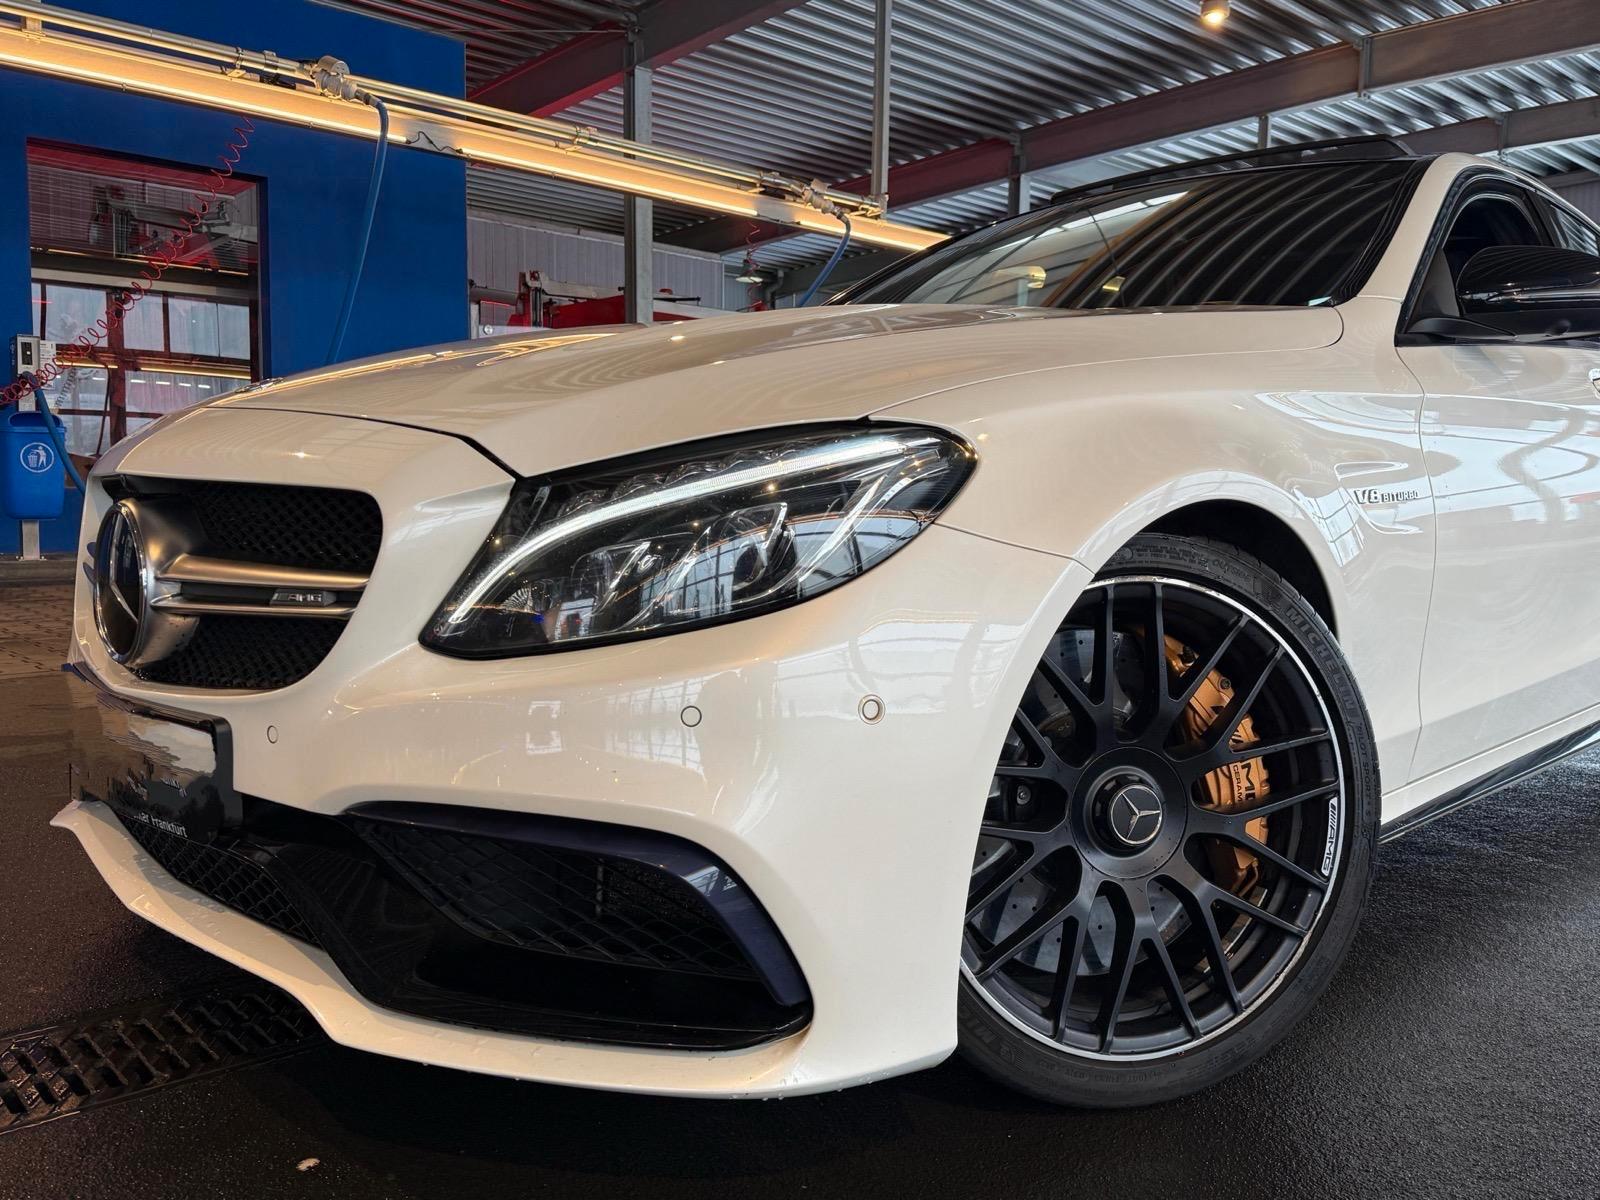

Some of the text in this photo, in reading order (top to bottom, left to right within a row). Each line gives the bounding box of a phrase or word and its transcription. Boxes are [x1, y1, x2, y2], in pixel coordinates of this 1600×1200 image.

[1354, 489, 1419, 504] V8 BITURBO
[1286, 608, 1360, 717] MICHELIN
[1233, 765, 1243, 802] CERAM
[1357, 725, 1368, 757] PILOT
[1363, 762, 1371, 799] SPORT
[1323, 825, 1335, 871] AMG
